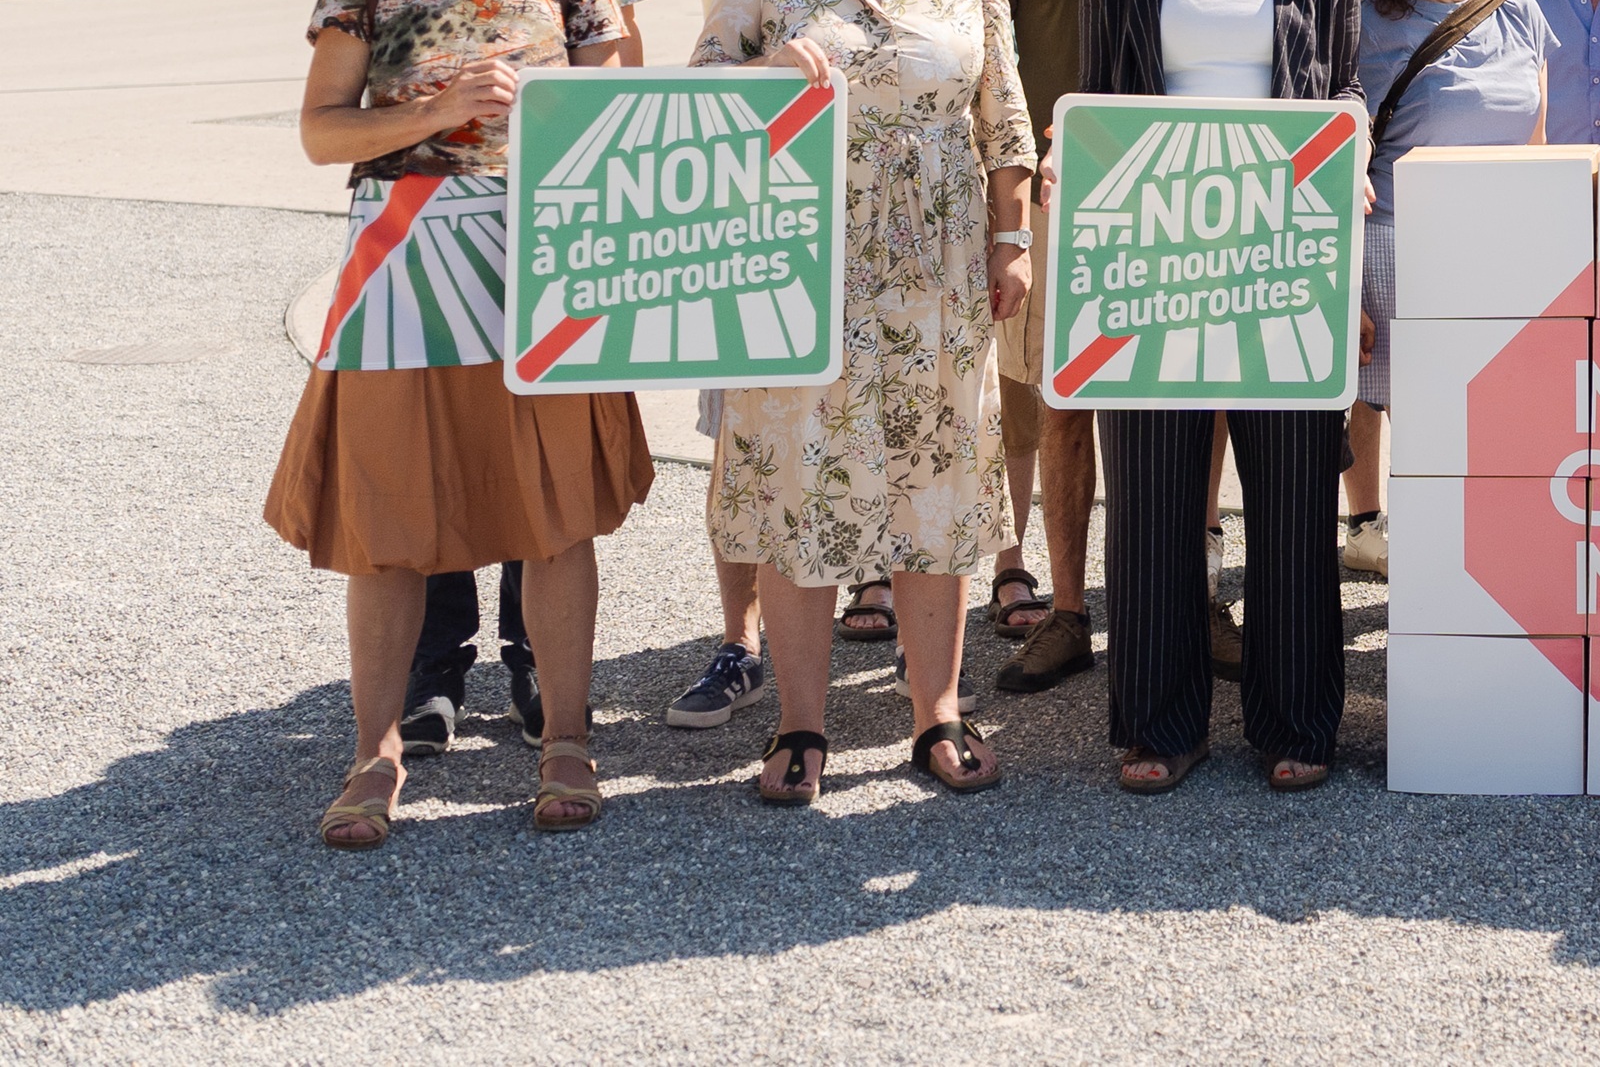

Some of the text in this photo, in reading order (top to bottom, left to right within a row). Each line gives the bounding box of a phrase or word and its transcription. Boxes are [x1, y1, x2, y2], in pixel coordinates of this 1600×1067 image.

[606, 137, 761, 225] NON
[1140, 166, 1286, 247] NON
[532, 203, 819, 276] à de nouvelles
[1070, 230, 1338, 295] à de nouvelles
[571, 251, 790, 311] autoroutes
[1106, 277, 1311, 330] autoroutes
